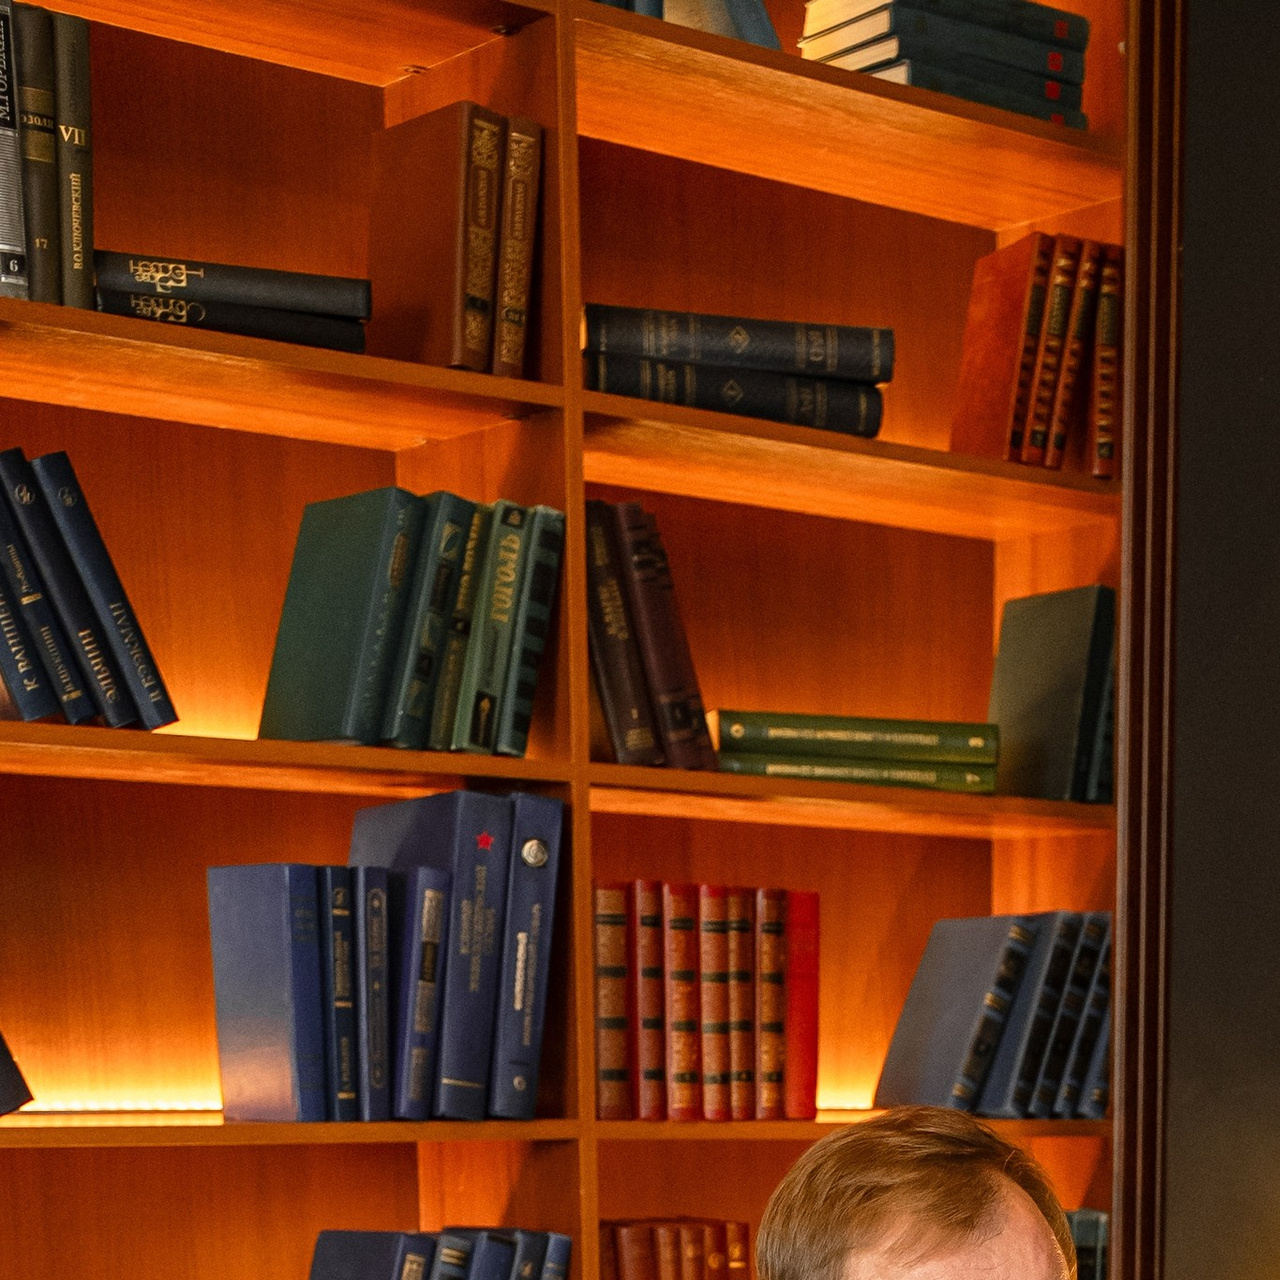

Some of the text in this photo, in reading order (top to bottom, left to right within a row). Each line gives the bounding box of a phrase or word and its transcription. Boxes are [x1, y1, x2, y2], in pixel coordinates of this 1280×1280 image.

[58, 123, 88, 148] VII
[34, 238, 49, 250] 17
[8, 259, 19, 273] 6
[489, 533, 521, 623] ГОГОЛЬ
[78, 629, 118, 703] ЭЛЬЧИН
